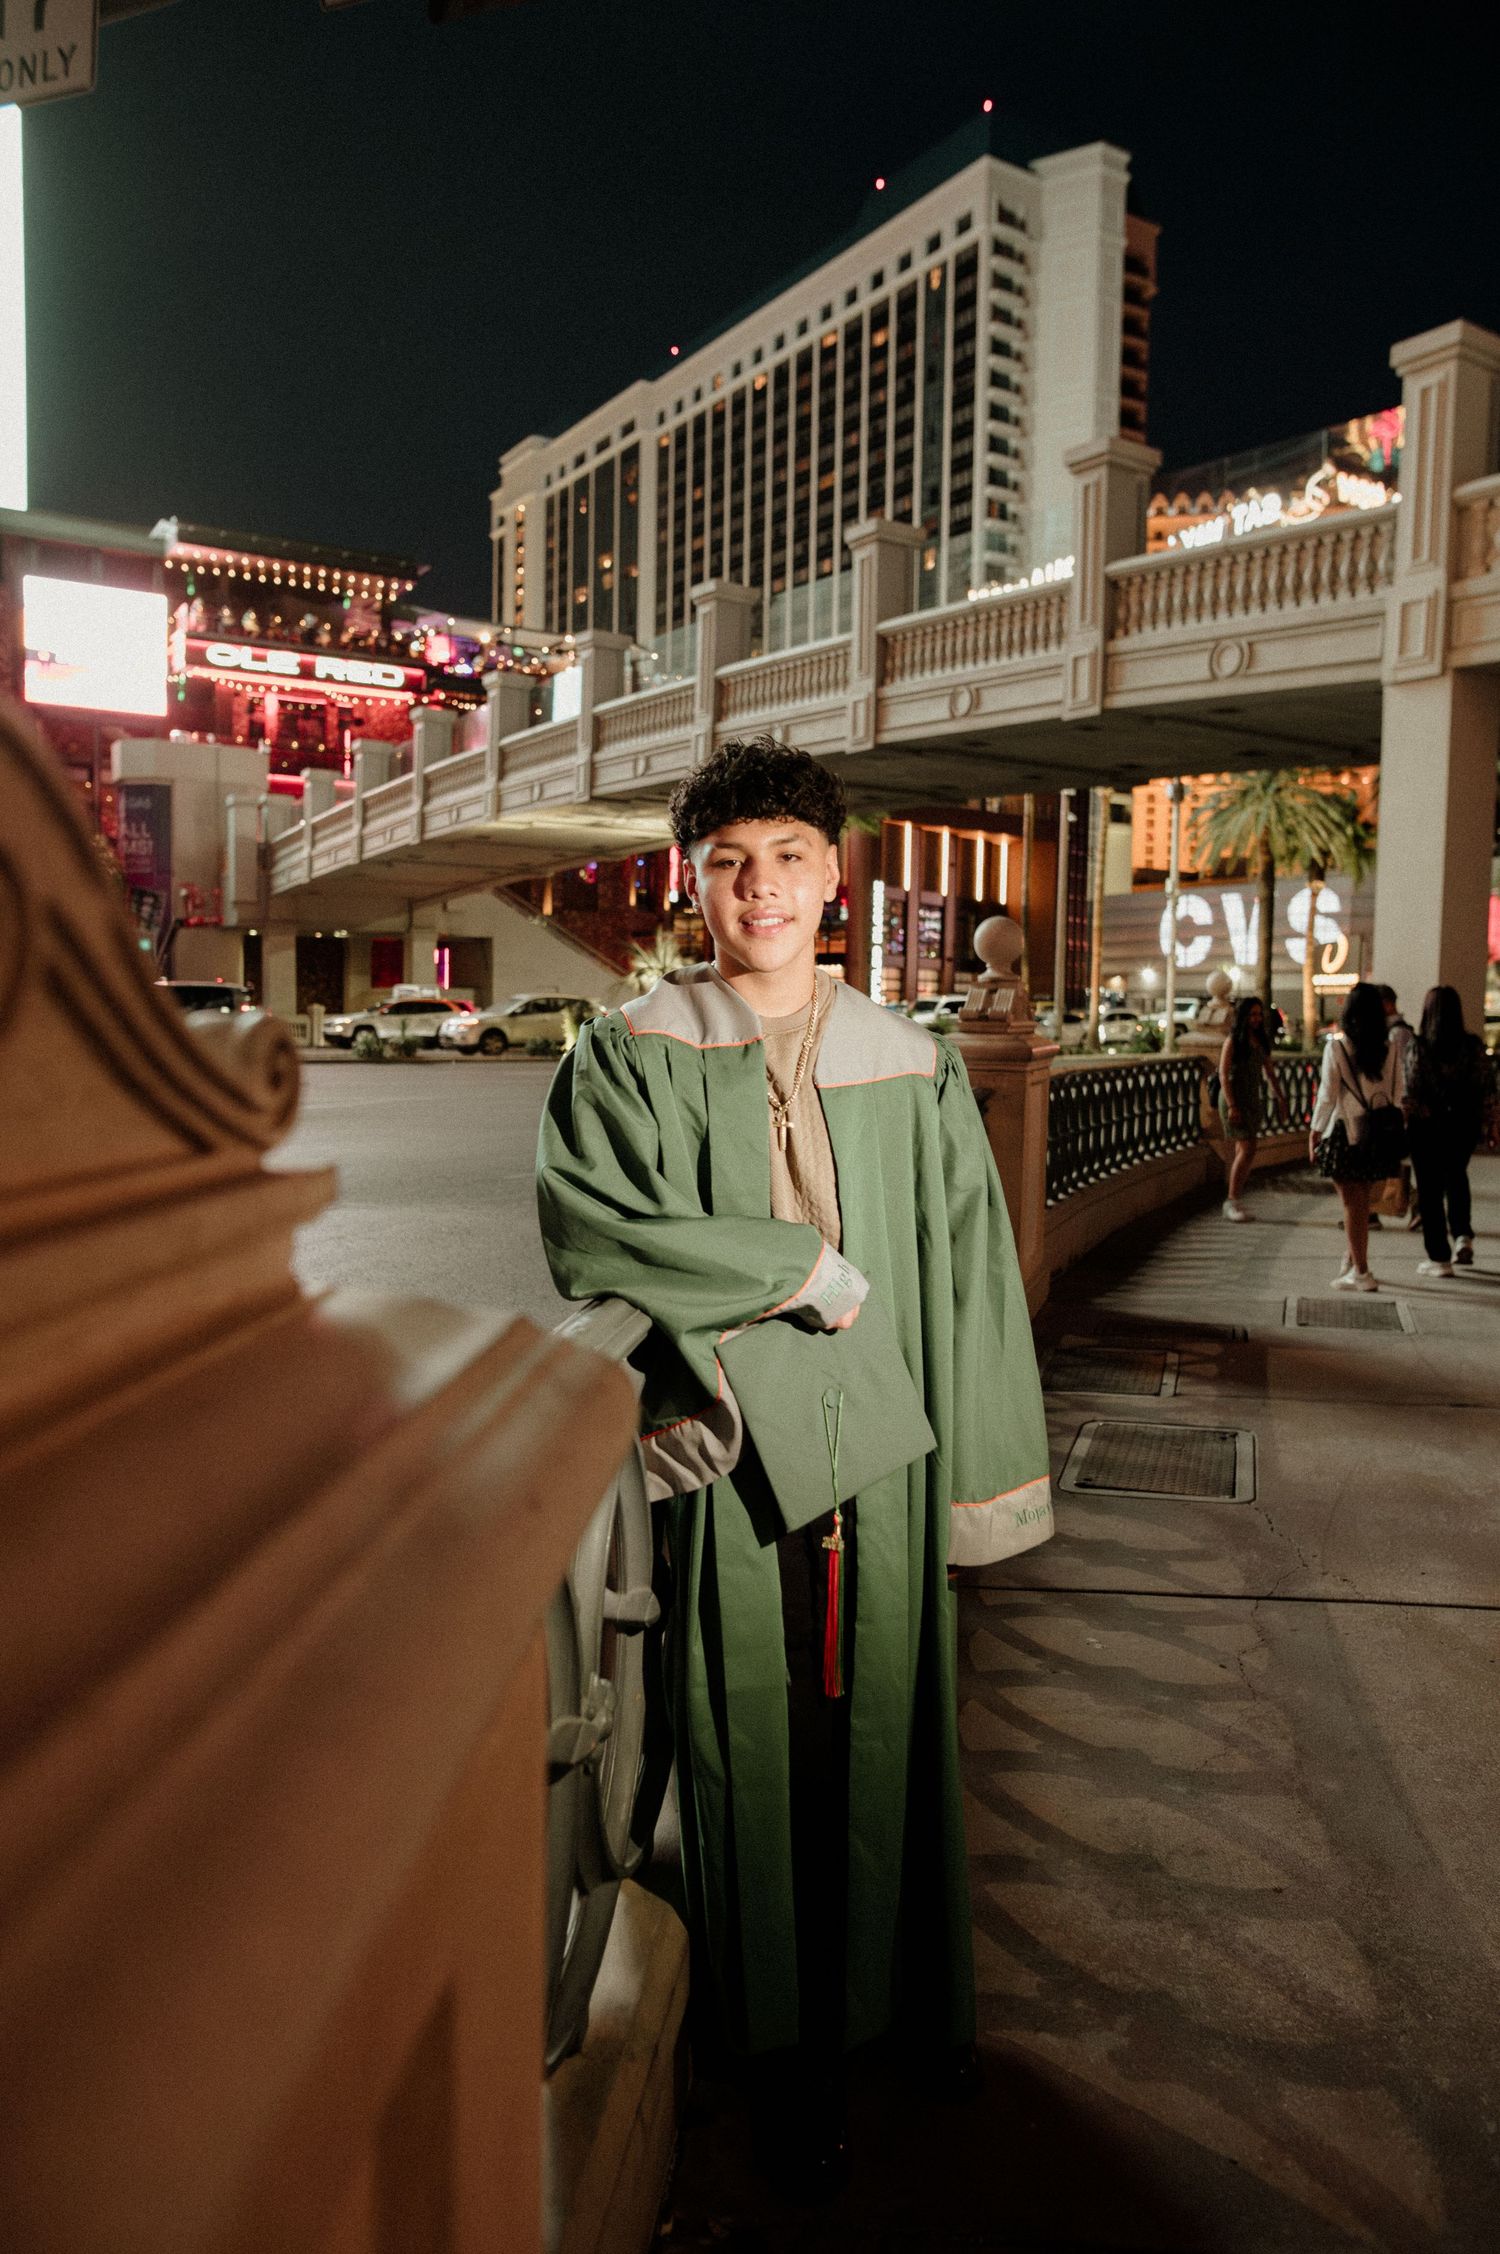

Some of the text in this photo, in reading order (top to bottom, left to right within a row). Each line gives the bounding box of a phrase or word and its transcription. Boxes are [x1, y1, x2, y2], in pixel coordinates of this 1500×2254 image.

[0, 43, 77, 91] ONLY
[206, 643, 404, 688] OLE RED
[1160, 887, 1342, 968] CVS
